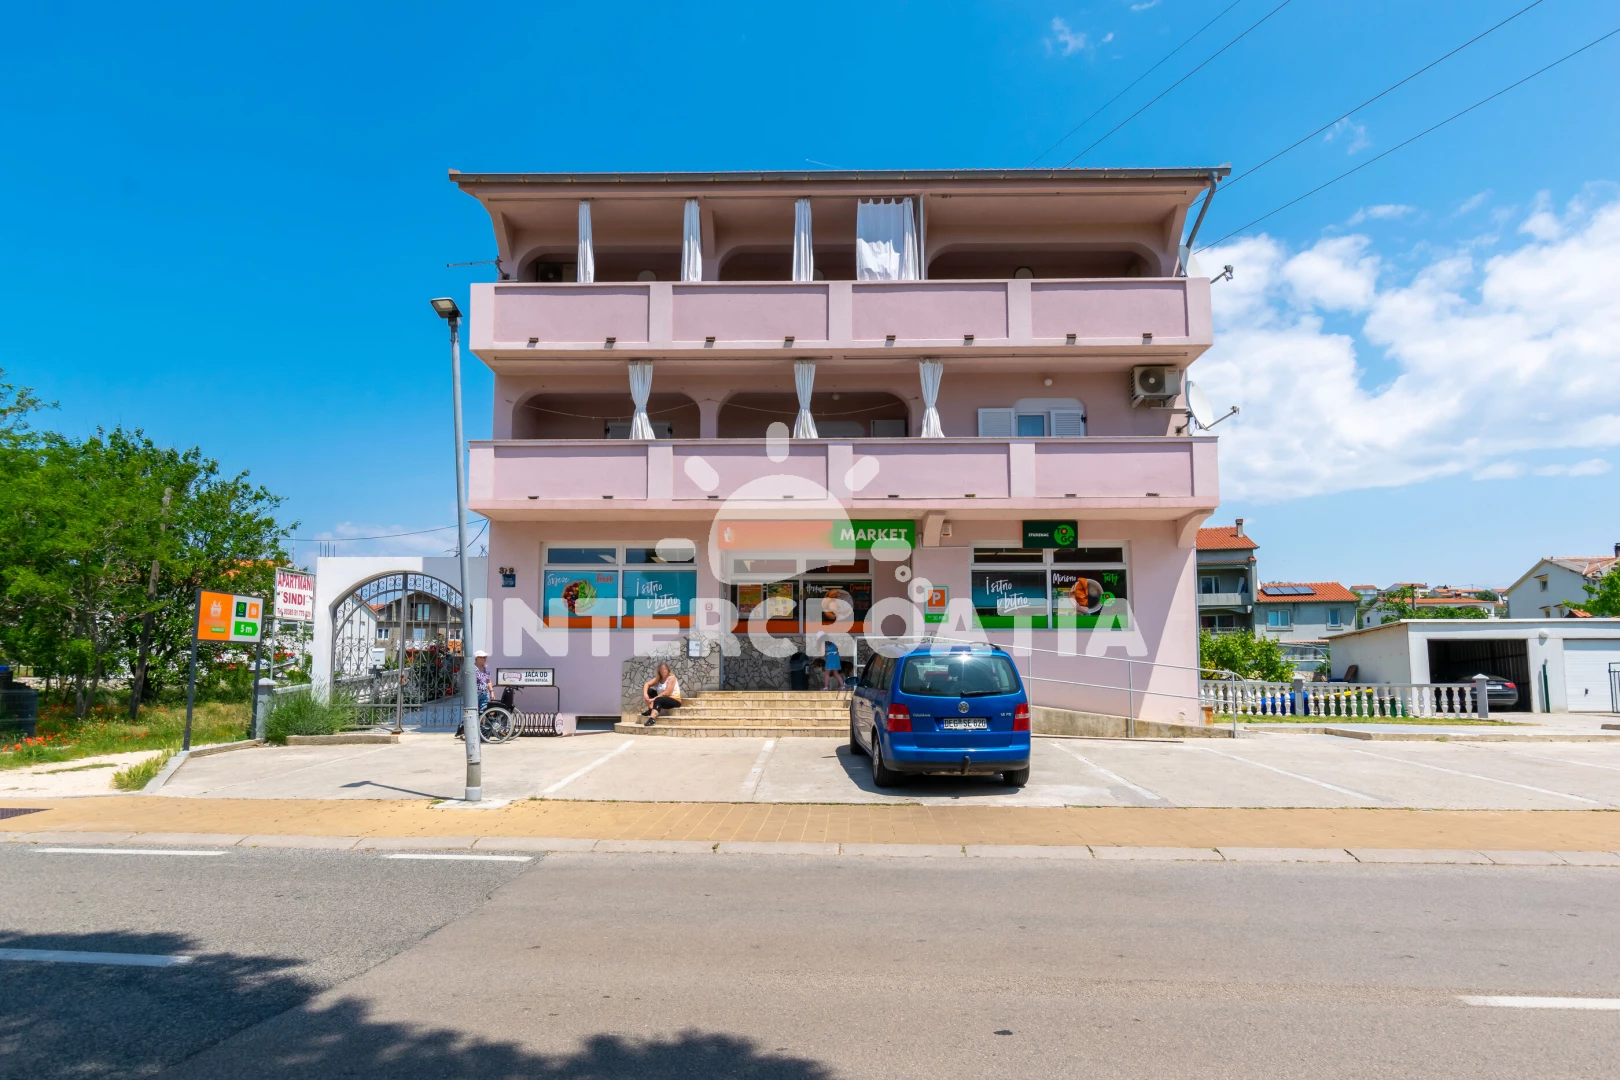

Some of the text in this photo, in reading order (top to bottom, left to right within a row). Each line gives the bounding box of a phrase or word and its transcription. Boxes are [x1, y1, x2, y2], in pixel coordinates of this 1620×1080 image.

[840, 528, 907, 541] MARKET
[641, 580, 663, 595] sitno
[991, 579, 1012, 595] sitno
[932, 591, 941, 604] P
[240, 624, 245, 633] 5
